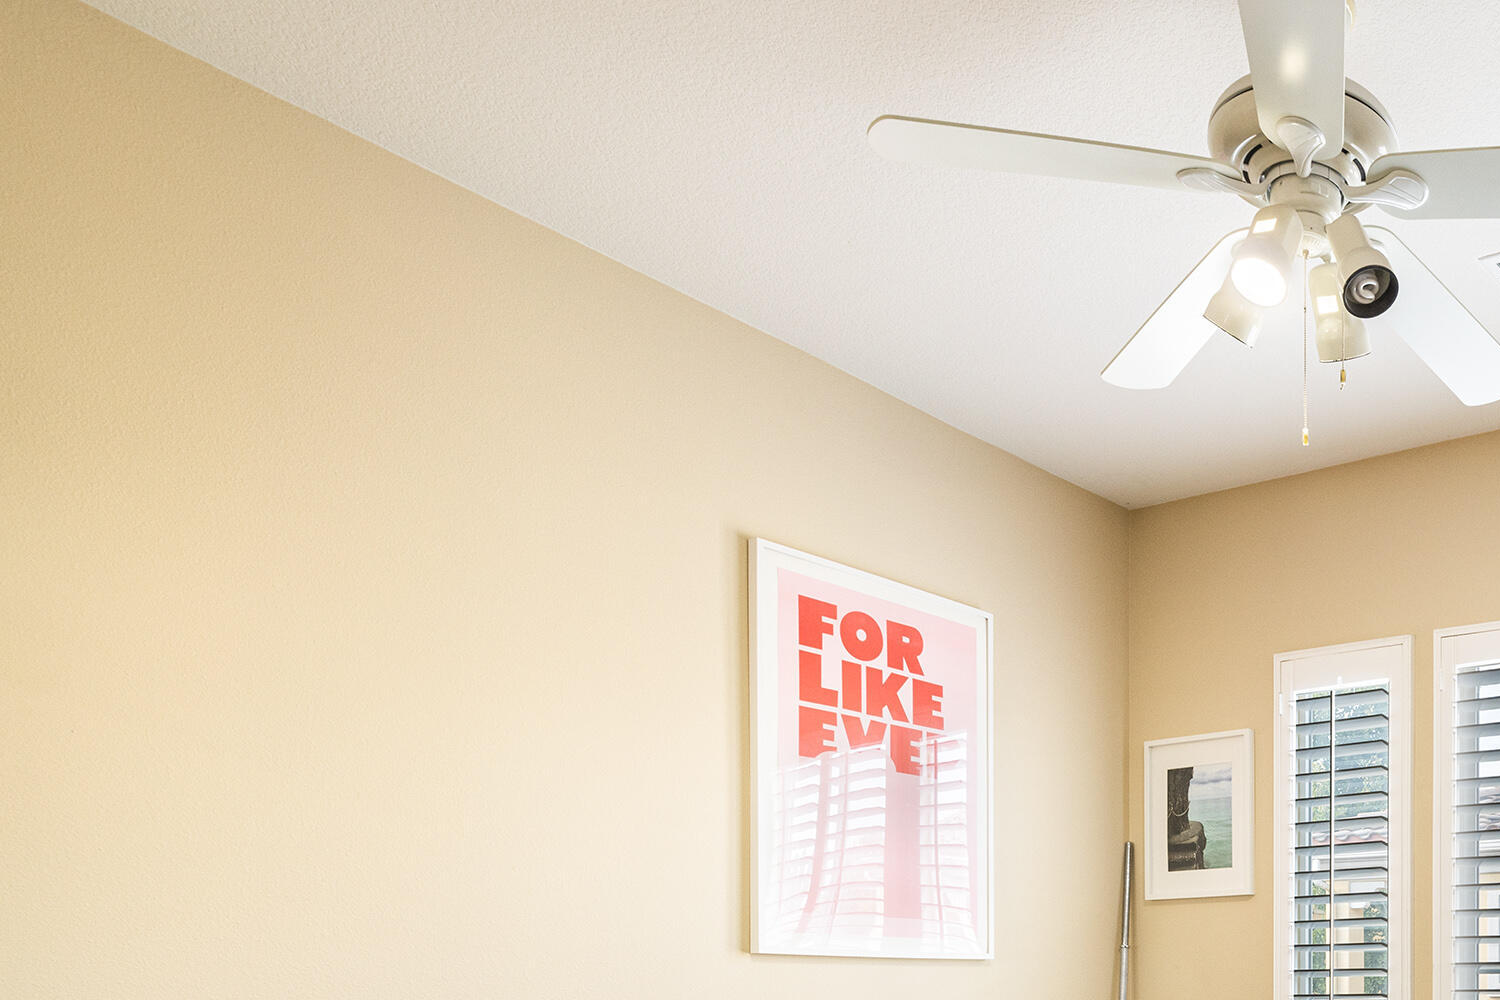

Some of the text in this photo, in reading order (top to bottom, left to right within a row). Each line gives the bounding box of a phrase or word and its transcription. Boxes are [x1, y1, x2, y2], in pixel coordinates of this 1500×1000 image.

[798, 594, 925, 676] FOR
[798, 649, 945, 731] LIKE
[798, 705, 944, 777] EVE
